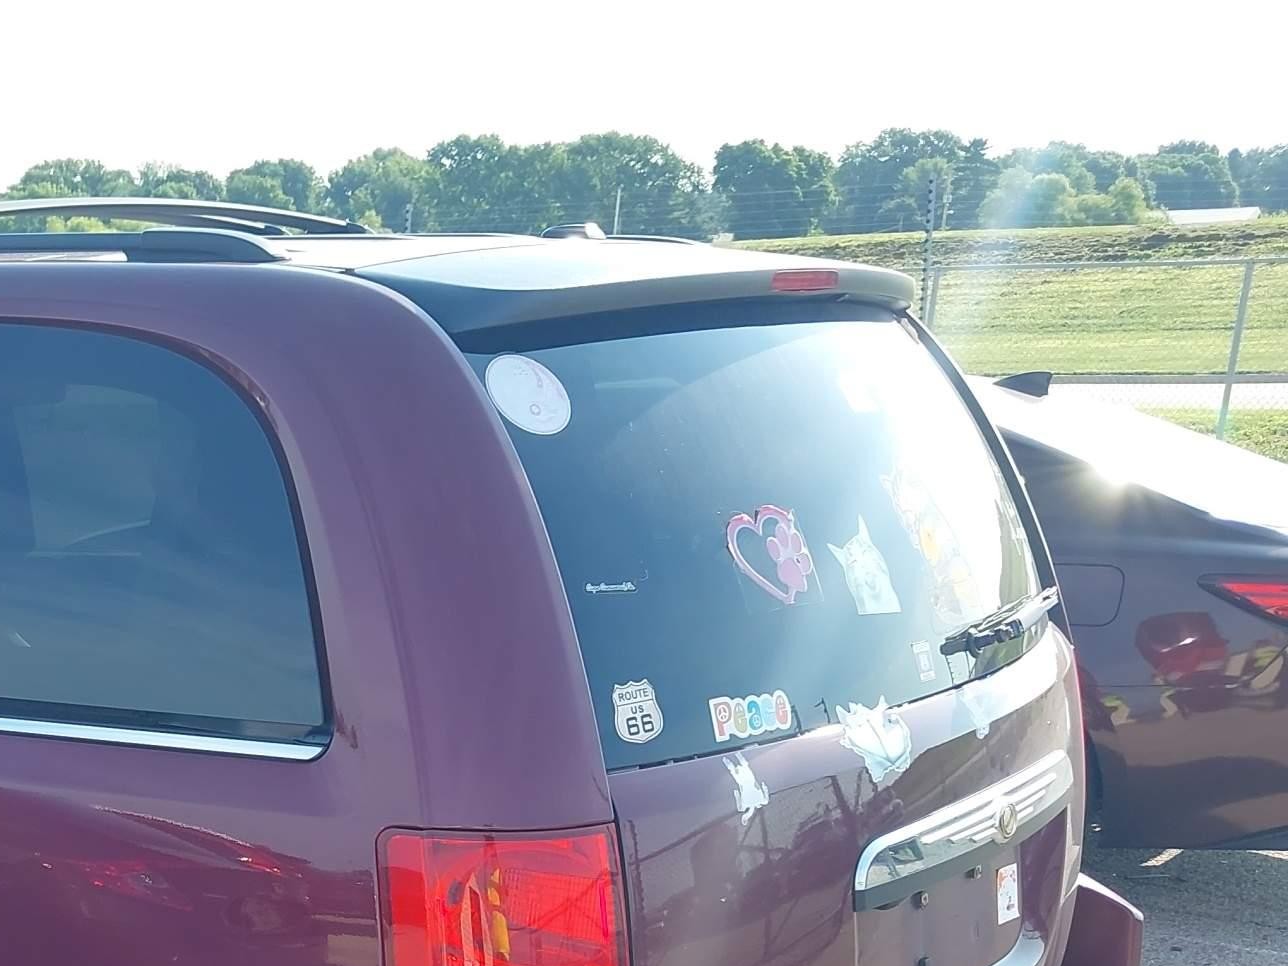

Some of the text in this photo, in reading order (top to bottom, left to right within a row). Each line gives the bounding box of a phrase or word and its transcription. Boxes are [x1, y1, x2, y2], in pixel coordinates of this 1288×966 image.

[618, 688, 650, 703] ROUTE
[631, 705, 645, 715] US
[626, 714, 655, 736] 66
